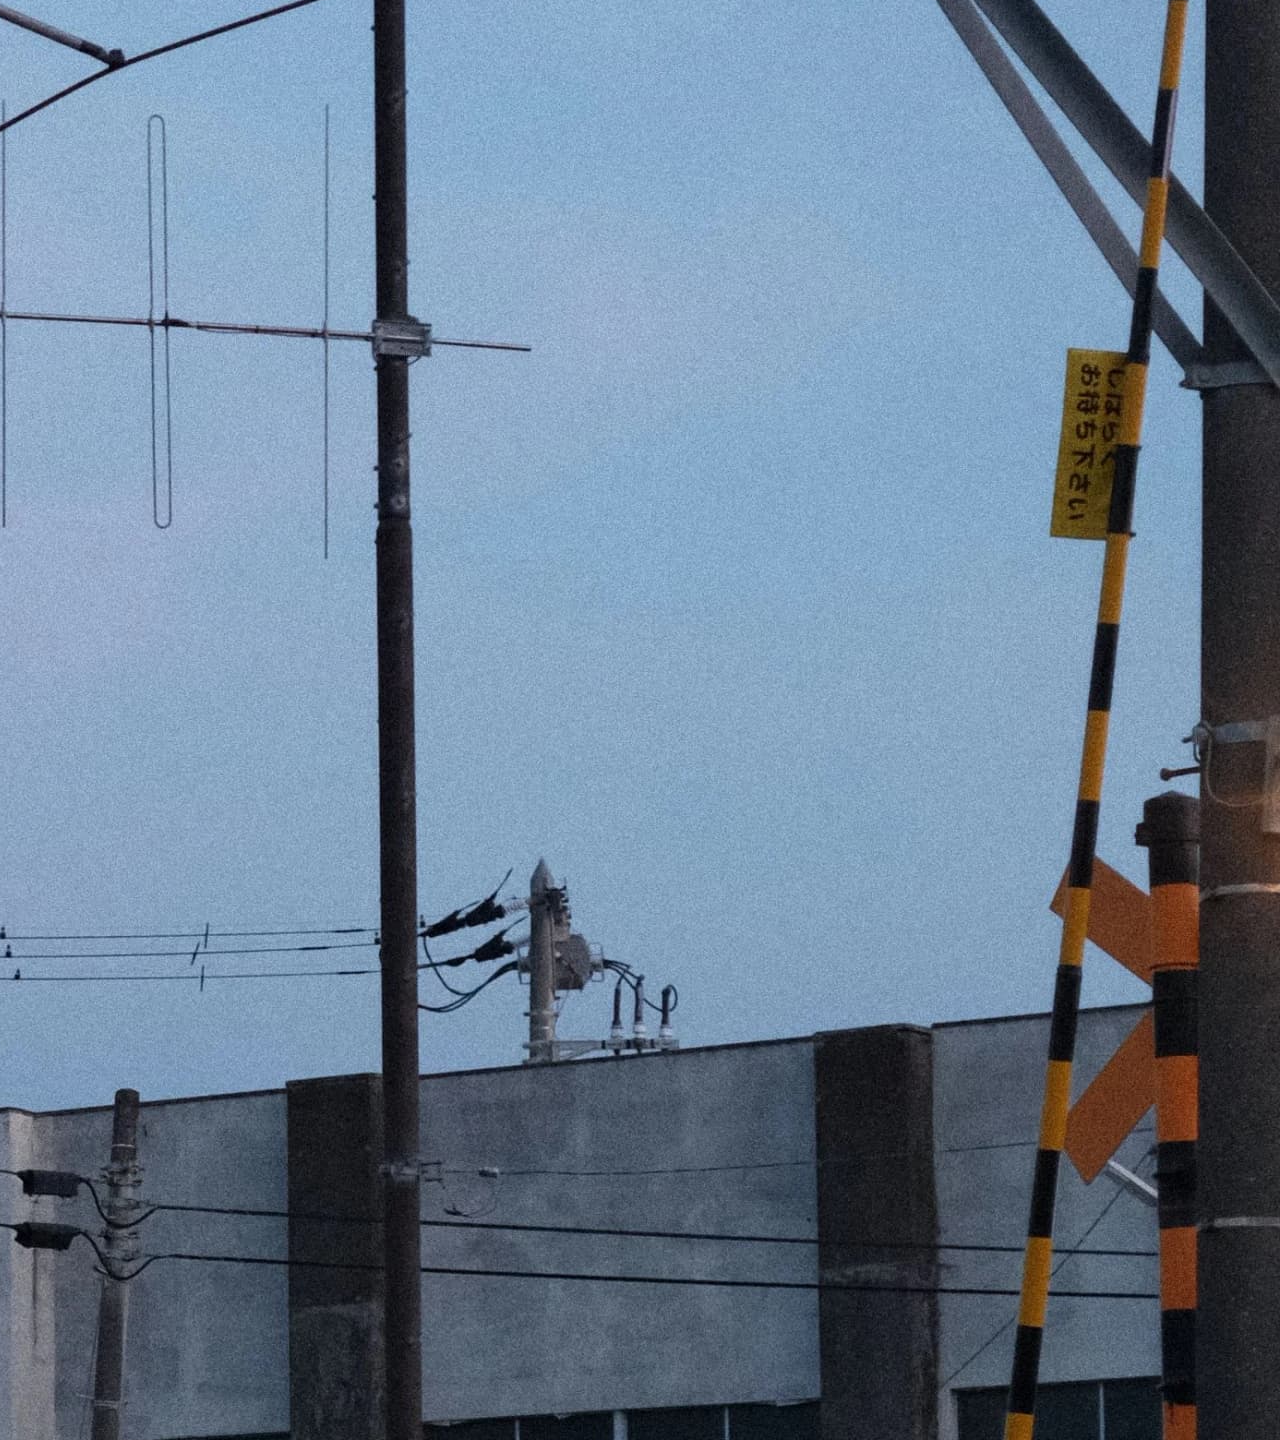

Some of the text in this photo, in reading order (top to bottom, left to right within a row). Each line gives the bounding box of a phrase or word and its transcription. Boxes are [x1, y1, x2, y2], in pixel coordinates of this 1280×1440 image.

[1068, 363, 1102, 521] お待ち下さい
